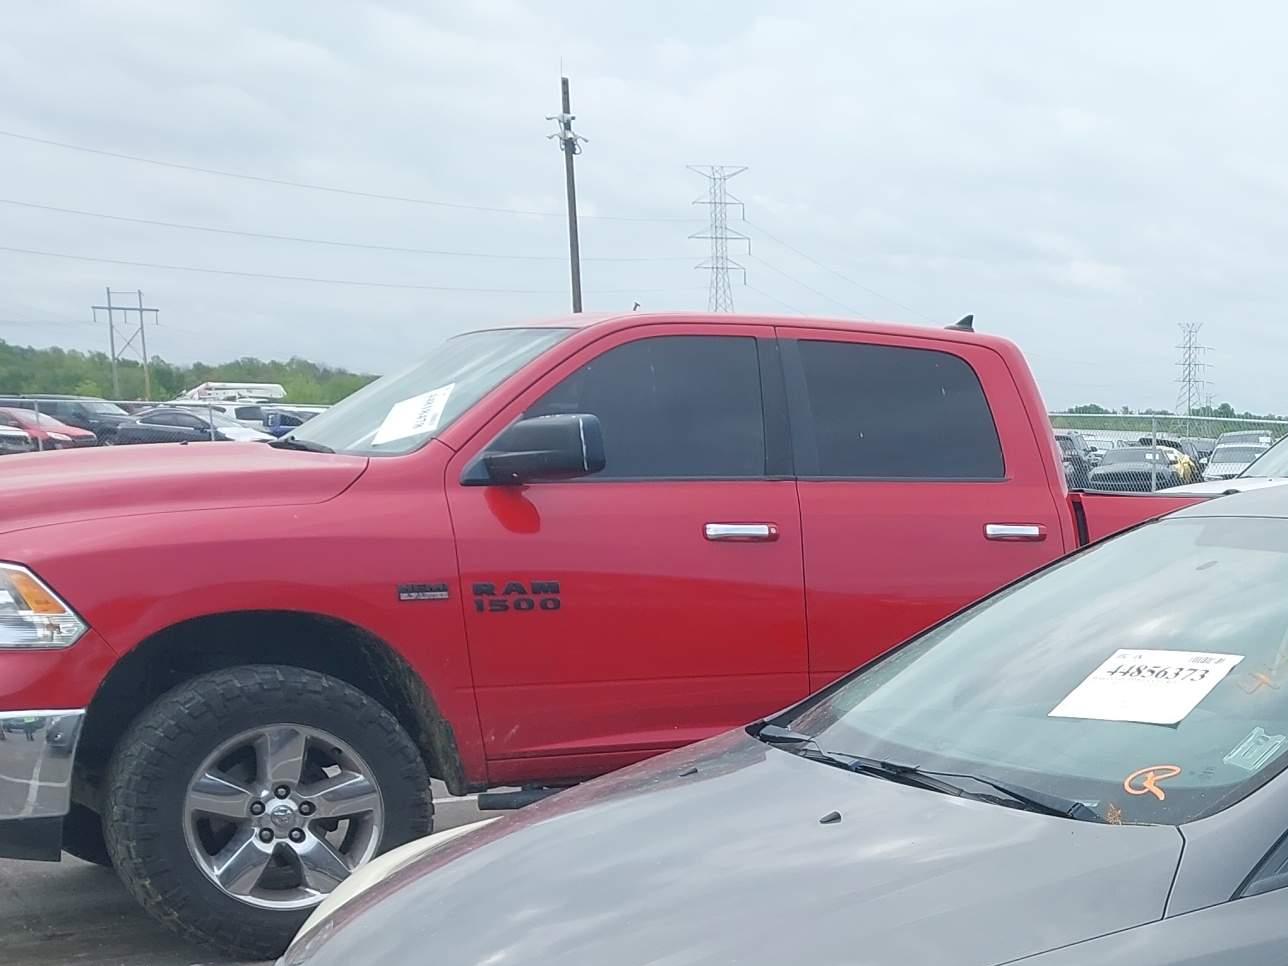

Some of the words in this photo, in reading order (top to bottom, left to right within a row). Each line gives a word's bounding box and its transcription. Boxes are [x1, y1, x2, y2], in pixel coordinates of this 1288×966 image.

[472, 581, 561, 596] RAM
[474, 597, 561, 613] 1500
[1106, 664, 1210, 682] 44856373
